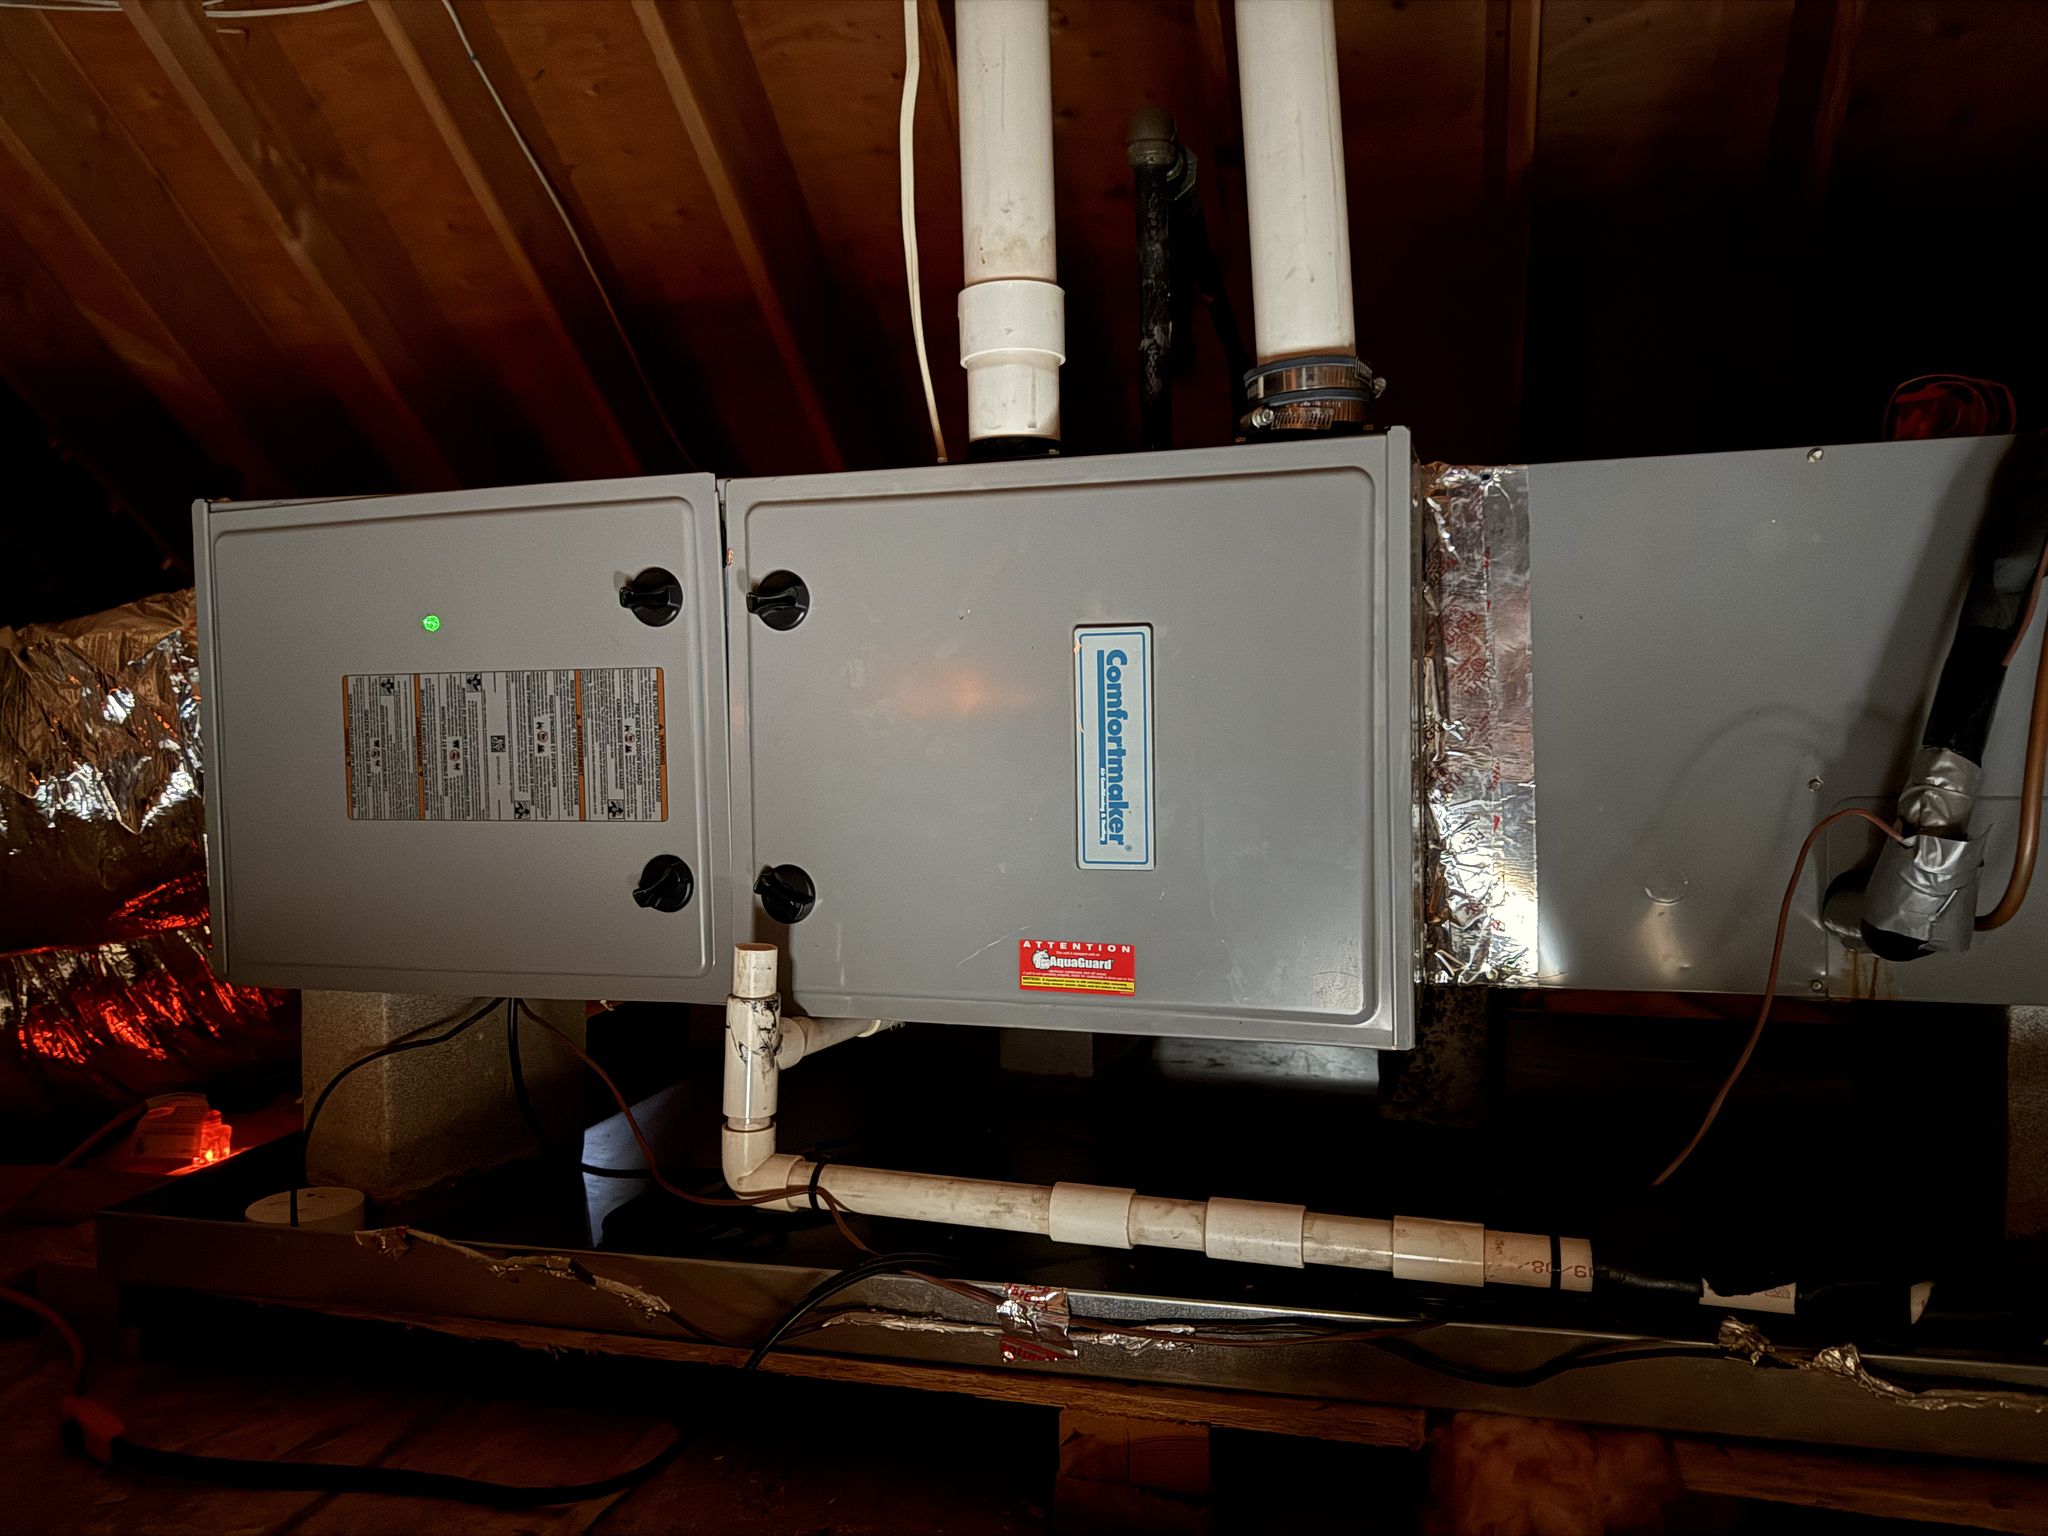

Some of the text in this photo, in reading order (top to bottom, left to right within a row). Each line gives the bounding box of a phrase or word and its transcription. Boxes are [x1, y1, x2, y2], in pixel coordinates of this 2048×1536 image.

[1106, 649, 1129, 846] Comfortmaker
[1023, 941, 1130, 953] ATTENTION
[1050, 956, 1113, 969] AquaGuard
